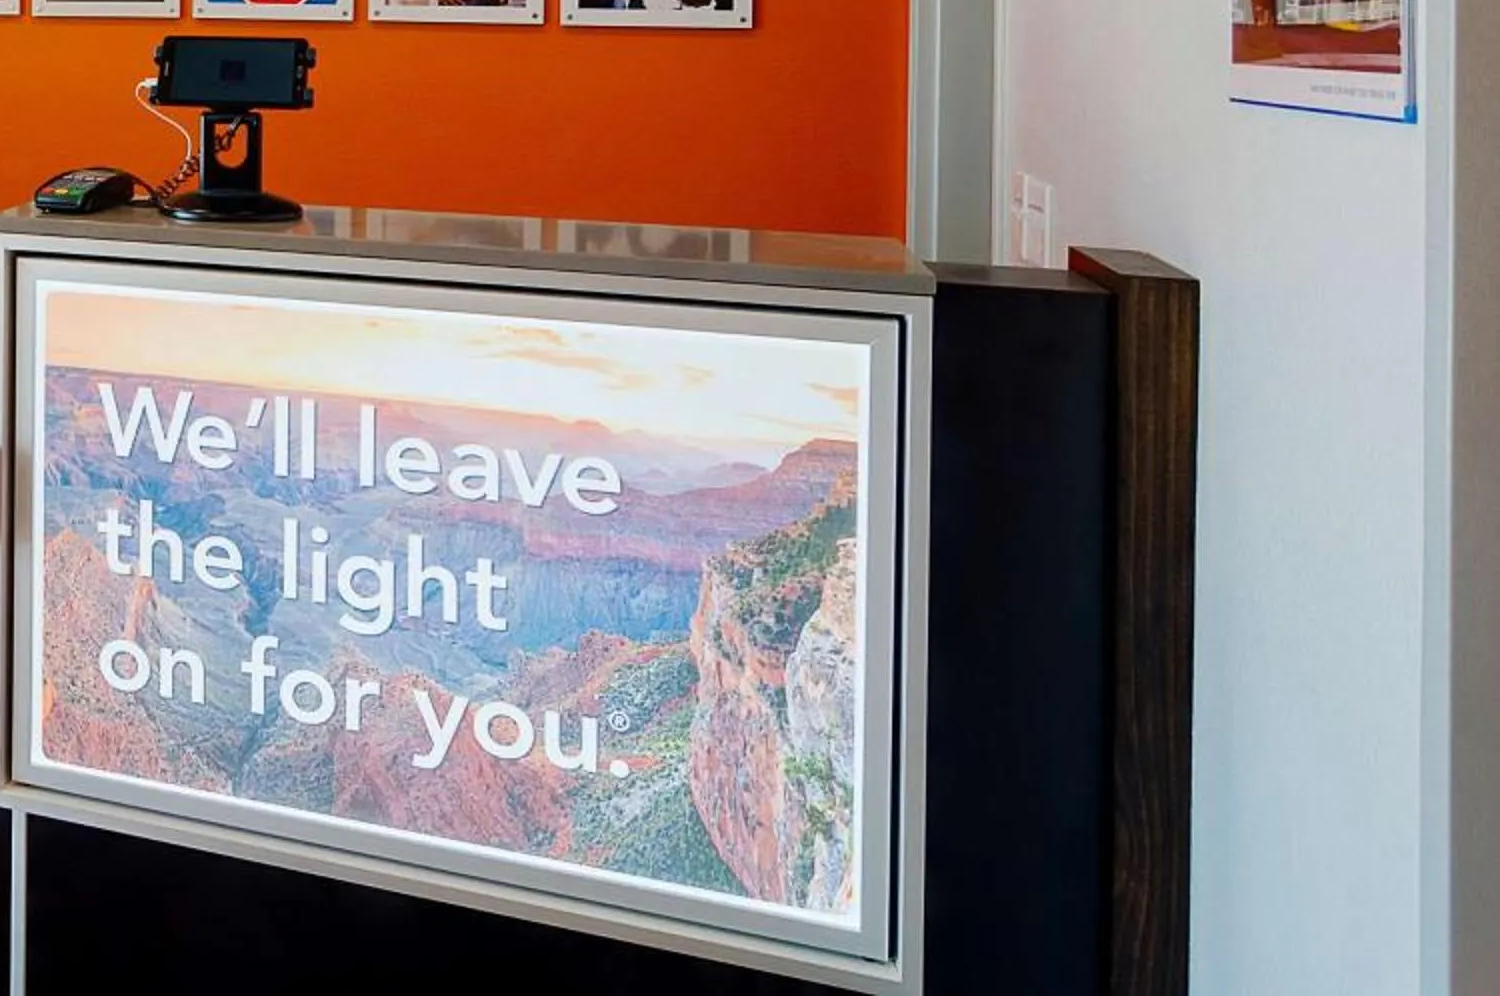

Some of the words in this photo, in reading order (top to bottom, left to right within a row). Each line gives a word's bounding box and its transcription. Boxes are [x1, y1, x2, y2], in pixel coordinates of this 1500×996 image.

[98, 382, 317, 481] We'll
[358, 403, 623, 516] leave
[98, 499, 243, 590] the
[282, 517, 508, 636] light
[99, 639, 206, 704] on
[241, 635, 381, 732] for
